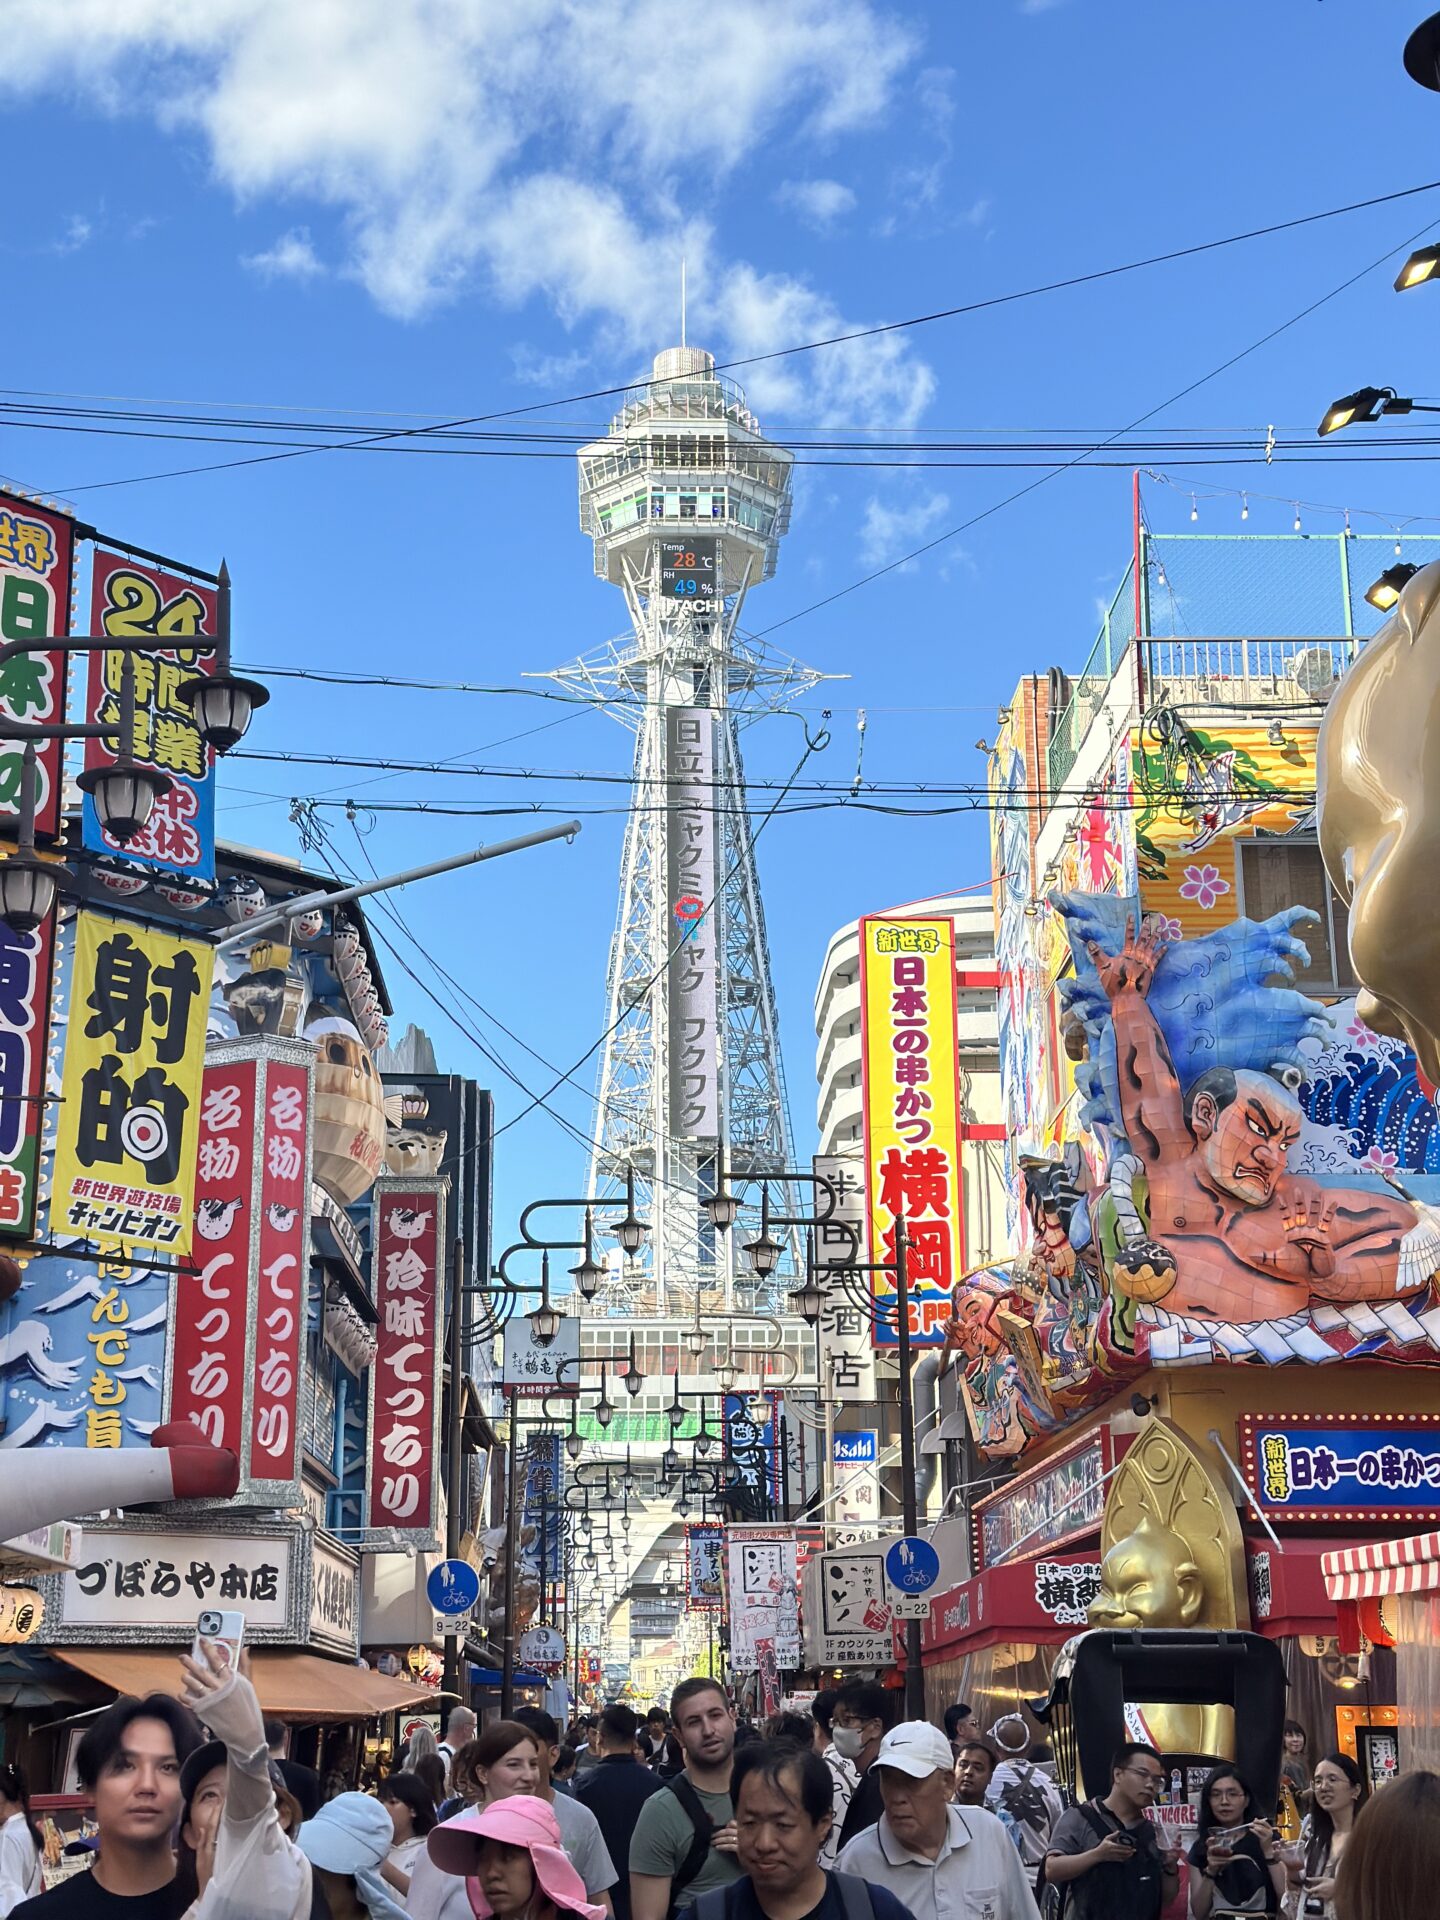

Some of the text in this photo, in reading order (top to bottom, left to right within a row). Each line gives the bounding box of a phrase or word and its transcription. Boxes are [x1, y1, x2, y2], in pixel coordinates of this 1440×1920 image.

[662, 543, 685, 552] Temp
[673, 552, 695, 568] 28
[663, 571, 675, 579] RH
[674, 579, 713, 595] 49 %
[104, 570, 208, 664] 24
[0, 575, 49, 811] 日本の
[101, 697, 206, 778] 営業
[876, 928, 939, 953] 新世界
[75, 933, 201, 1186] 射的
[892, 955, 932, 1144] 日本一の串かつ
[679, 1017, 707, 1129] ワクワク
[71, 1177, 182, 1214] 新世界遊技場
[68, 1202, 183, 1244] チャンピオン
[880, 1147, 952, 1291] 横綱
[187, 1085, 242, 1448] 名物 てっちり
[257, 1085, 303, 1458] 名物 てっちり
[380, 1248, 427, 1518] 珍味てっちり
[834, 1439, 872, 1458] Asahi
[1265, 1438, 1290, 1500] 新世界
[75, 1558, 279, 1602] づぼらや本店
[437, 1619, 469, 1633] 9-22
[895, 1603, 928, 1616] 9-22
[735, 1655, 798, 1666] 宴会予付中
[825, 1652, 834, 1661] 2F
